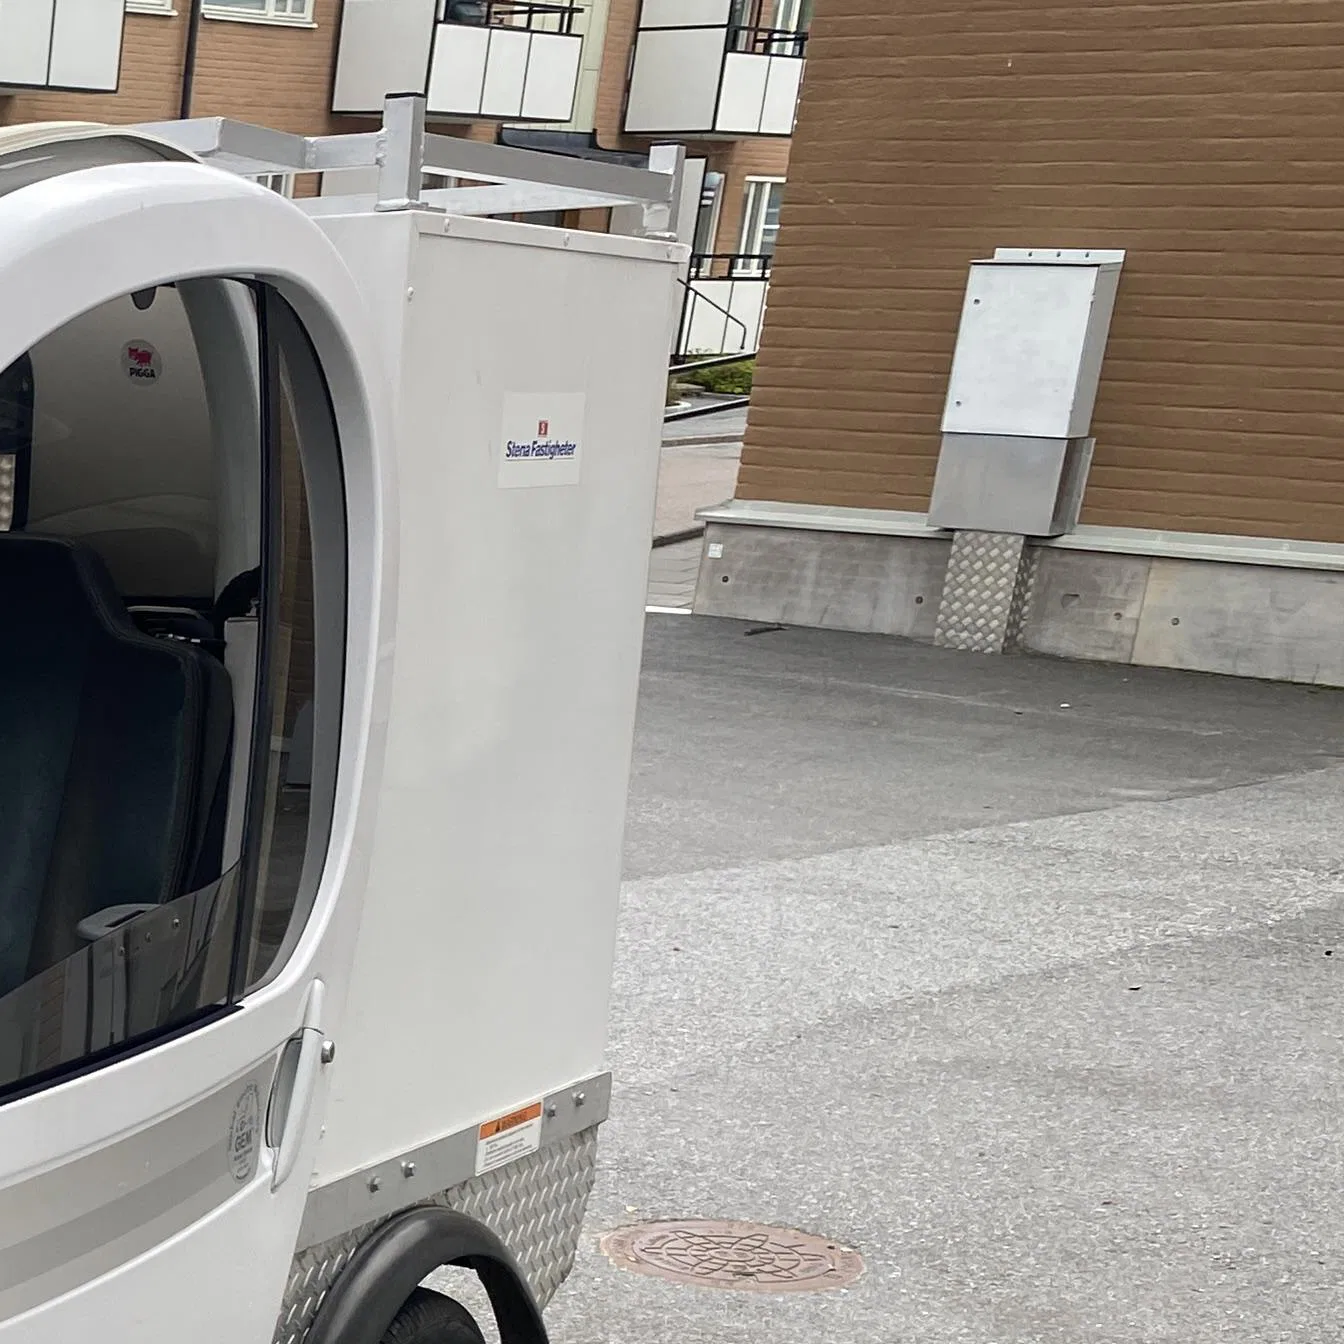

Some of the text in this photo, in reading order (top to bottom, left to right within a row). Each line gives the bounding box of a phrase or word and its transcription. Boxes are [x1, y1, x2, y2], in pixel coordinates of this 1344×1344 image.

[129, 367, 156, 379] PIGGA
[506, 440, 576, 459] Stena Fastigheter
